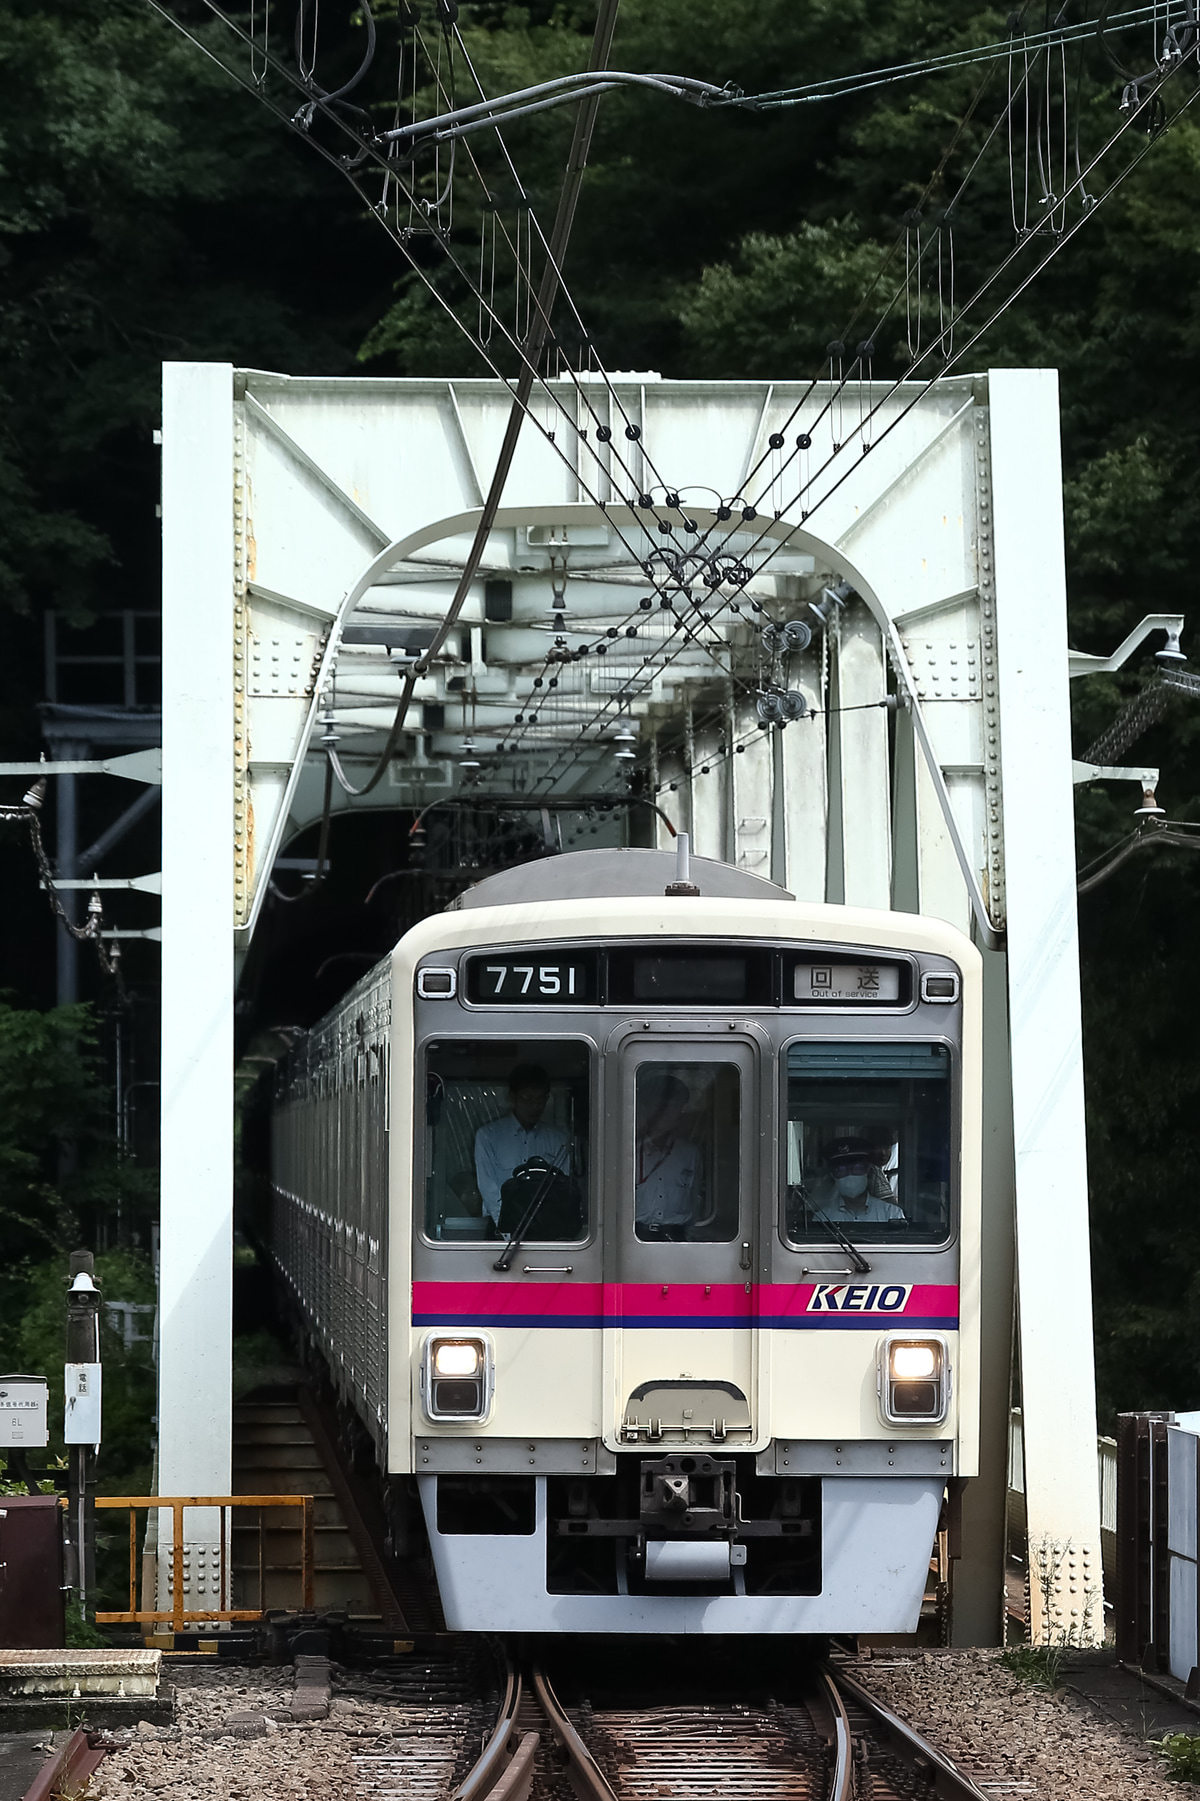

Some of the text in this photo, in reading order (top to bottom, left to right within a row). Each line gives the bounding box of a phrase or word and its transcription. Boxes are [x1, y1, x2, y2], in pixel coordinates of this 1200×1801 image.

[486, 966, 575, 994] 7751
[810, 966, 879, 990] 回送
[811, 989, 878, 998] Out of service
[811, 1285, 906, 1310] KEIO
